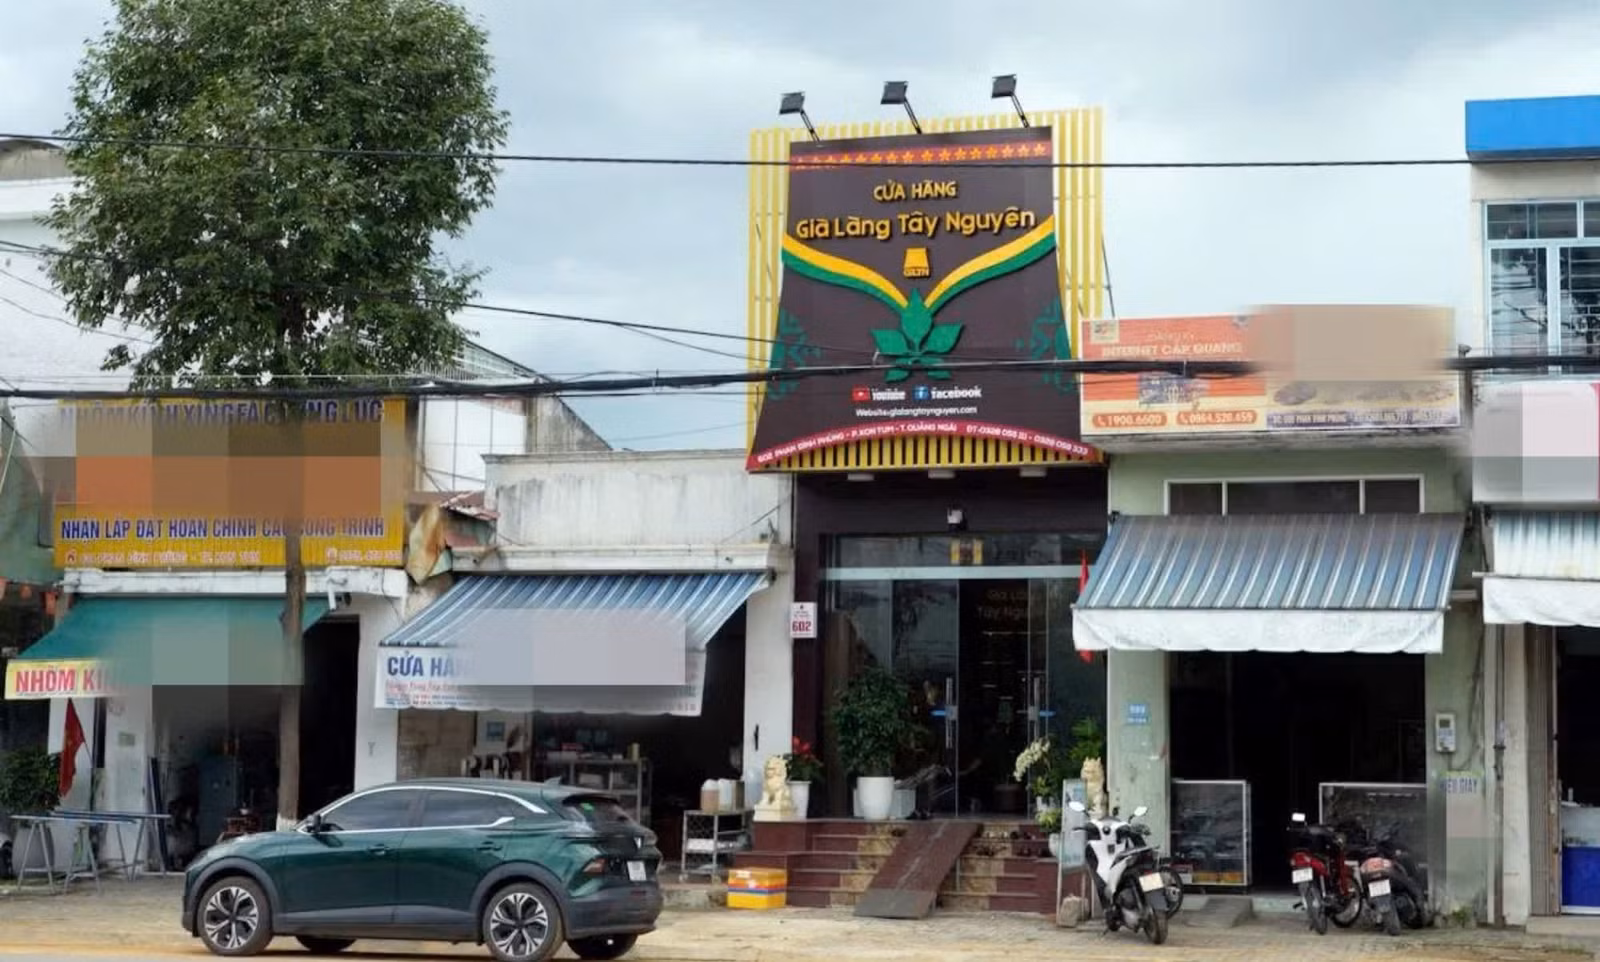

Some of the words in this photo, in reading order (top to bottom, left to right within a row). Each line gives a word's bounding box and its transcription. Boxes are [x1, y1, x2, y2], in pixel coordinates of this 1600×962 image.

[874, 179, 905, 200] CỬA
[912, 180, 957, 199] HÀNG
[796, 217, 829, 238] Già
[834, 215, 891, 239] Làng
[898, 210, 938, 237] Tây
[946, 206, 1035, 233] Nguyên
[792, 620, 812, 632] 602
